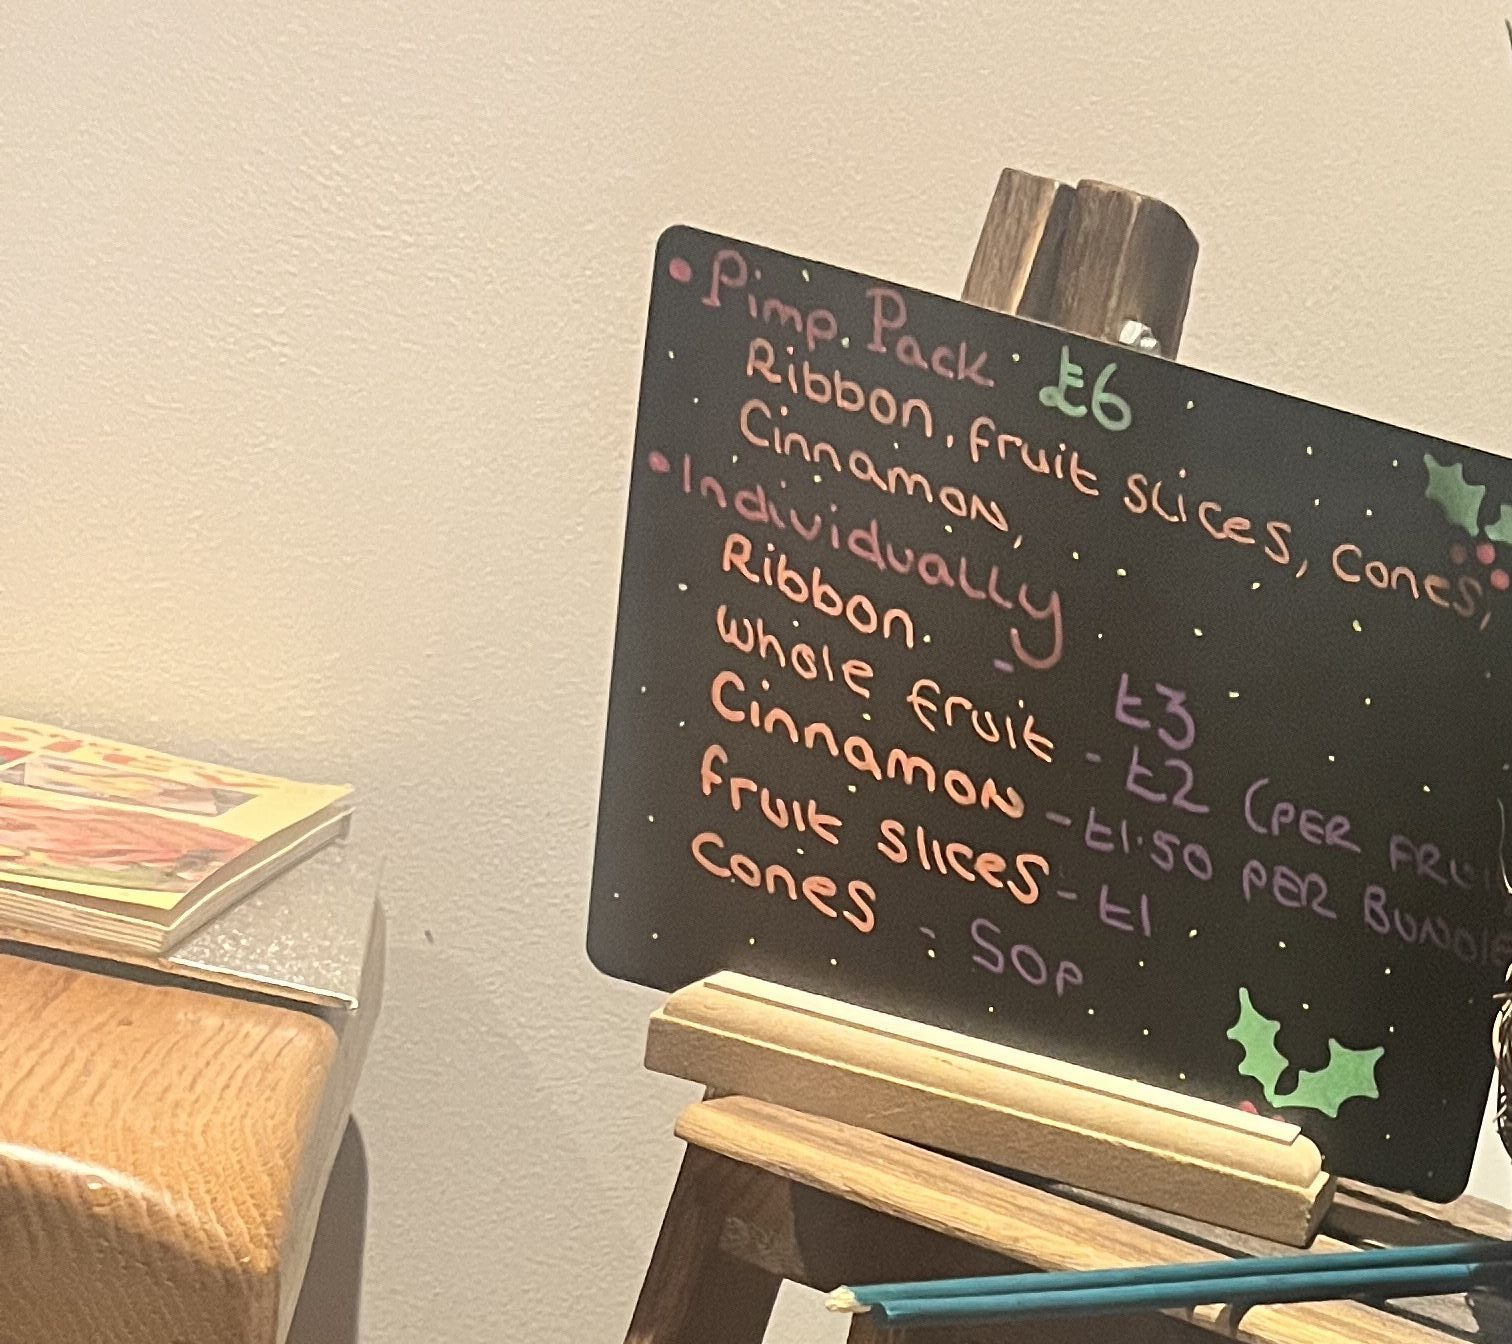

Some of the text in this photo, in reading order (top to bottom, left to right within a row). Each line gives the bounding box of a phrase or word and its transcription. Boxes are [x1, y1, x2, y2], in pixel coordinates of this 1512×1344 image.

[702, 248, 1132, 432] Pimp Pack £6
[970, 416, 1099, 497] fruit
[683, 452, 1063, 669] Individually
[907, 678, 1055, 763] fruit
[1241, 860, 1338, 921] PER
